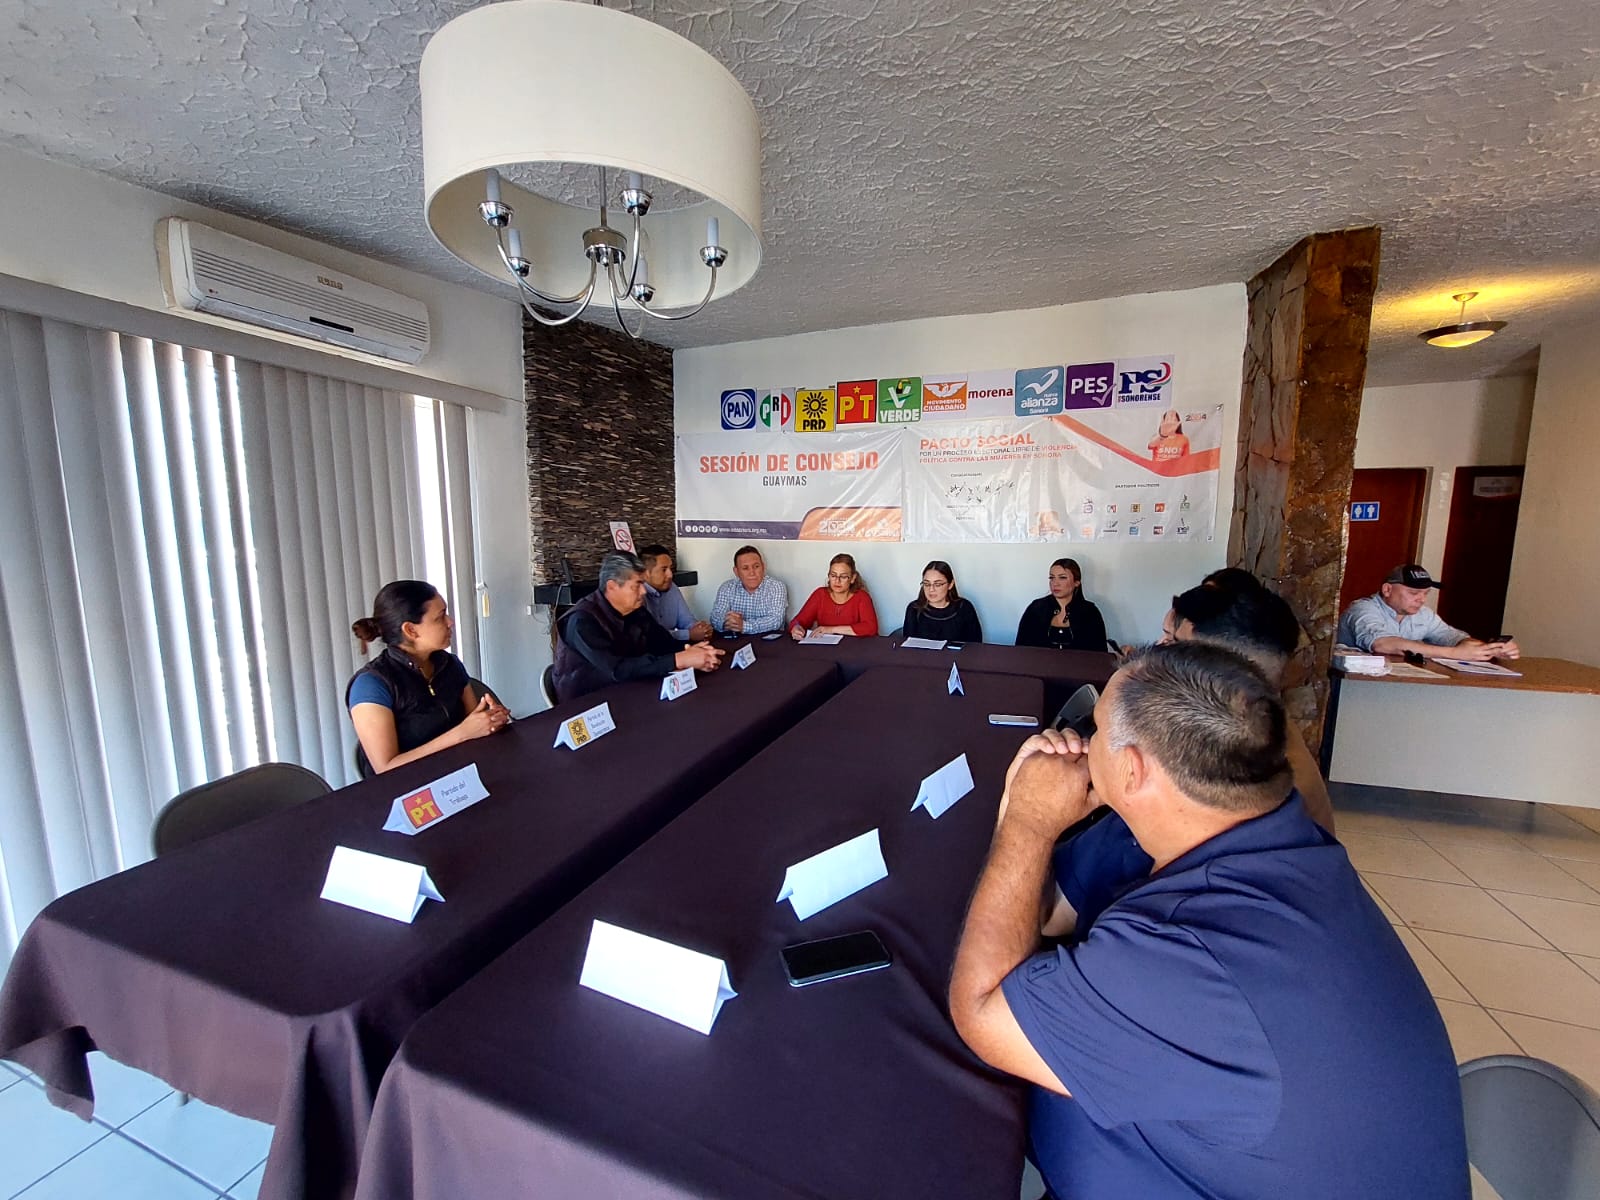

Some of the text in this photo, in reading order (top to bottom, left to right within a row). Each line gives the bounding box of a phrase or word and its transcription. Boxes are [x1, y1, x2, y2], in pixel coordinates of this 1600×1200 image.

[968, 388, 1013, 399] morena
[1071, 377, 1108, 395] PES
[727, 401, 749, 418] PAN
[762, 396, 788, 419] PRI
[840, 395, 873, 420] PT
[923, 403, 965, 411] CIUDADANO
[1021, 398, 1058, 408] alianza
[880, 409, 920, 422] VERDE
[803, 419, 826, 430] PRD
[920, 432, 1035, 449] PACTO SOCIAL
[699, 451, 879, 473] SESIÓN DE CONSEJO
[762, 475, 807, 487] GUAYMAS
[410, 800, 438, 826] PT
